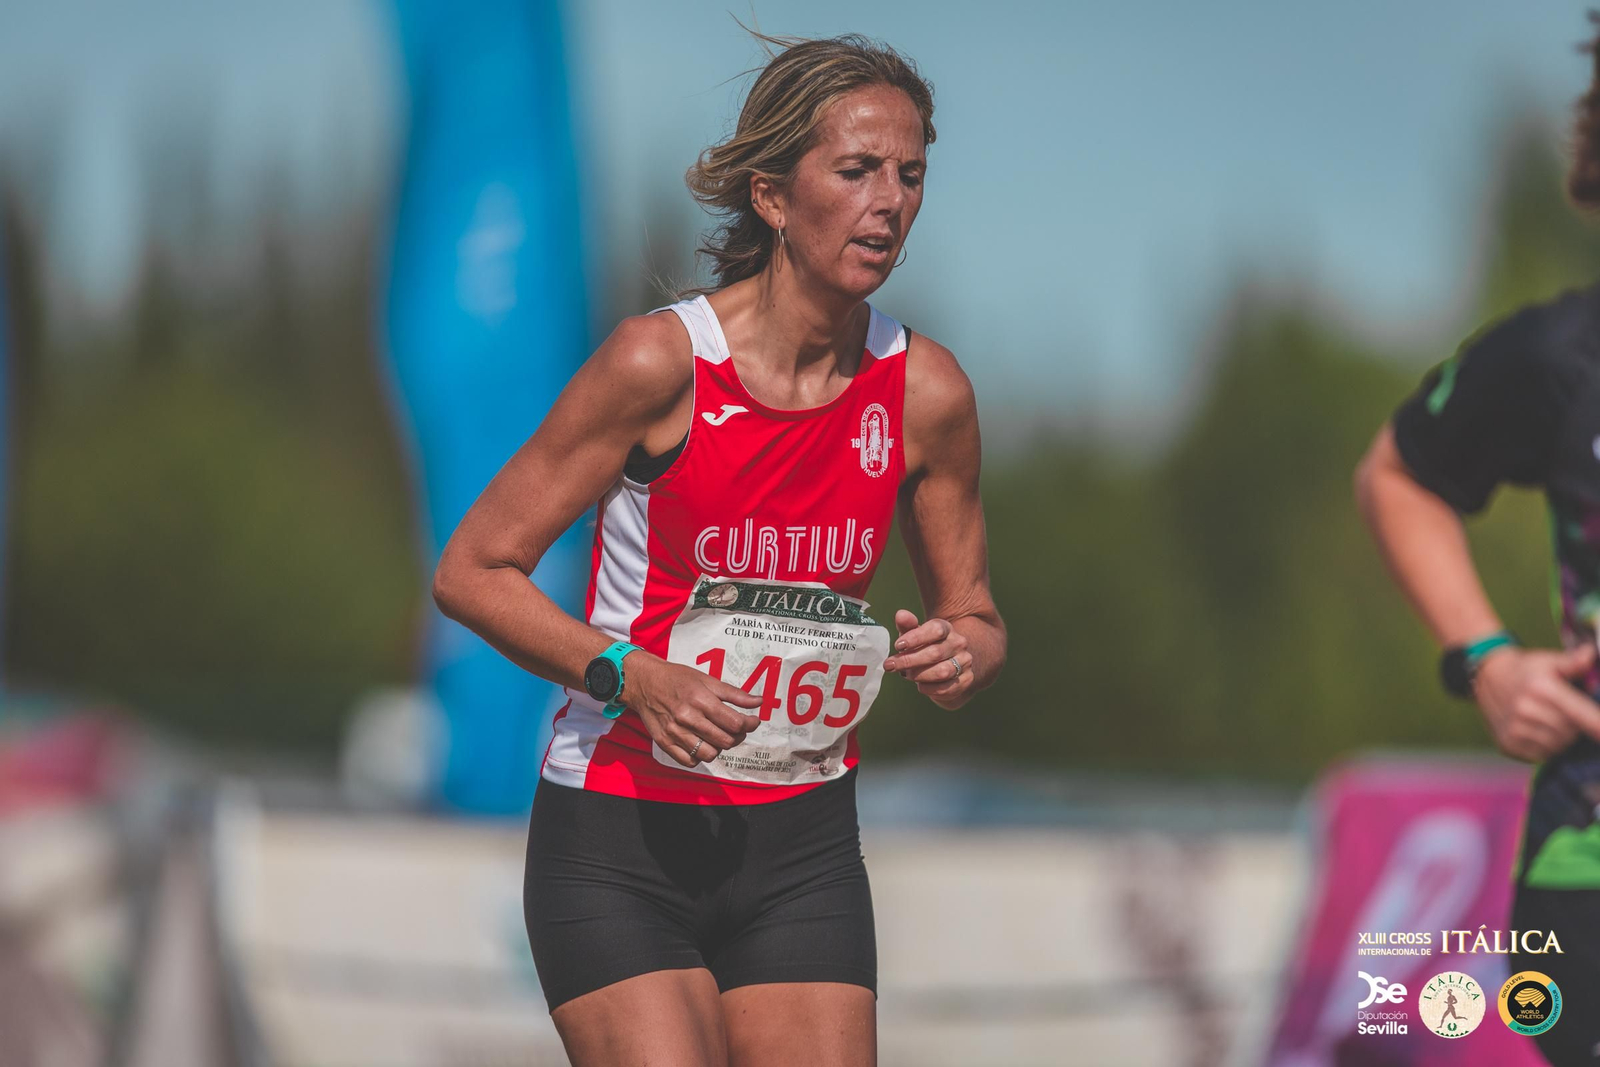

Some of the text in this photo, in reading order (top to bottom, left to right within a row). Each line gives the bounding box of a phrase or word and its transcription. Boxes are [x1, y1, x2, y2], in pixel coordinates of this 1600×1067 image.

[850, 438, 861, 449] 19
[863, 466, 887, 478] HUELVA
[694, 518, 875, 581] CURTIUS
[748, 608, 797, 617] INTERNATIONAL
[750, 588, 848, 617] ITÁLICA
[724, 627, 856, 651] CLUB DE ATLETISMO CURTIUS
[732, 617, 854, 640] MARÍA RAMÍREZ FERRERAS
[695, 647, 868, 728] 1465
[717, 754, 734, 762] CROSS
